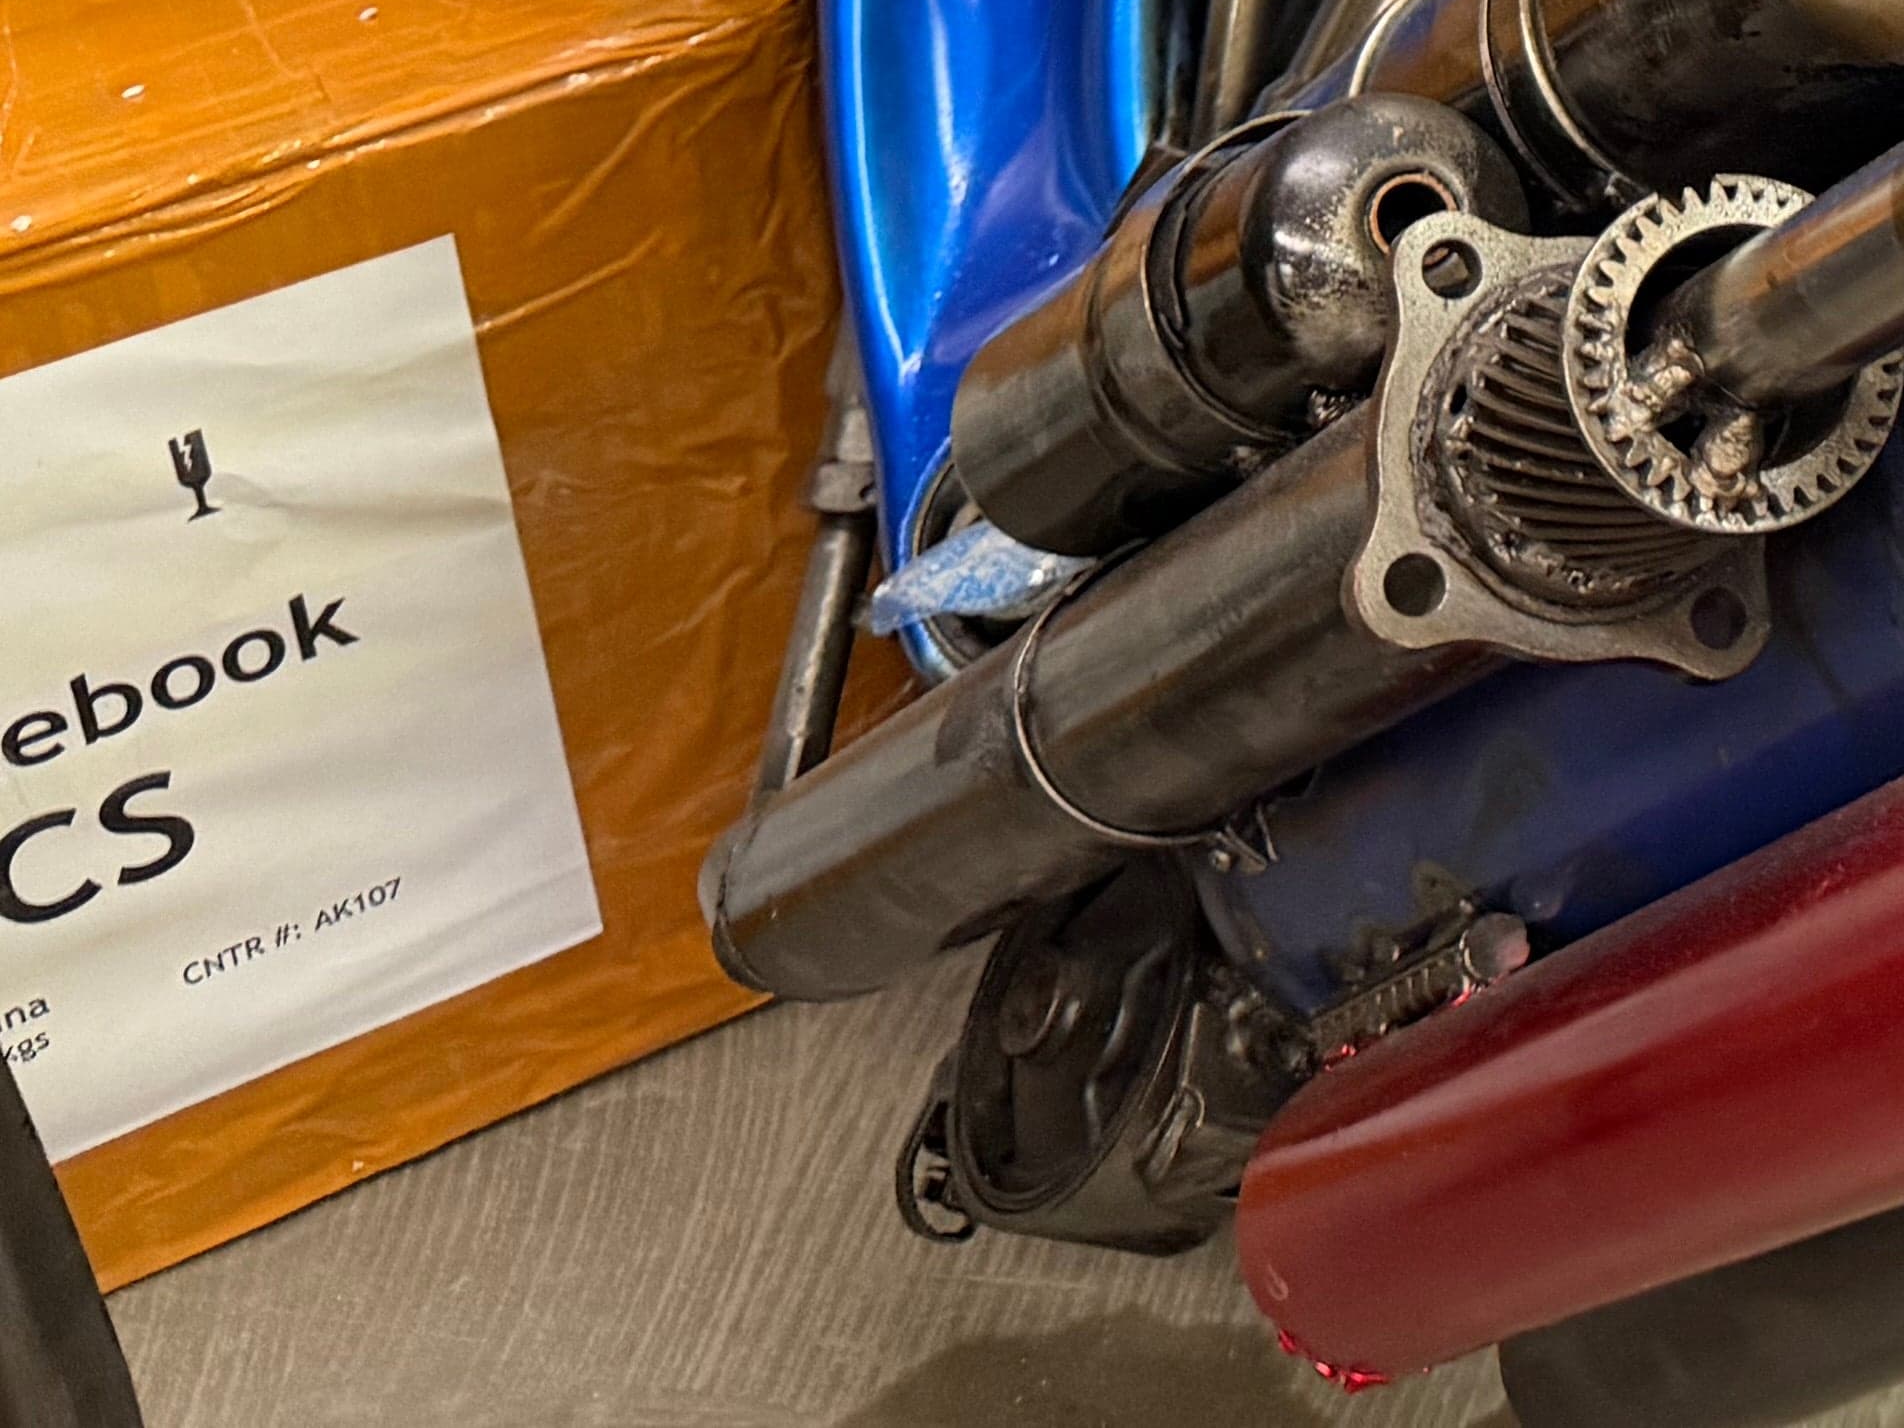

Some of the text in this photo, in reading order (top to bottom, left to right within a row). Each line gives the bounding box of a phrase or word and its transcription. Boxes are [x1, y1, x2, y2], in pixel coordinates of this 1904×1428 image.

[0, 770, 196, 925] CS
[182, 936, 265, 986] CNTR
[314, 876, 402, 932] AK107
